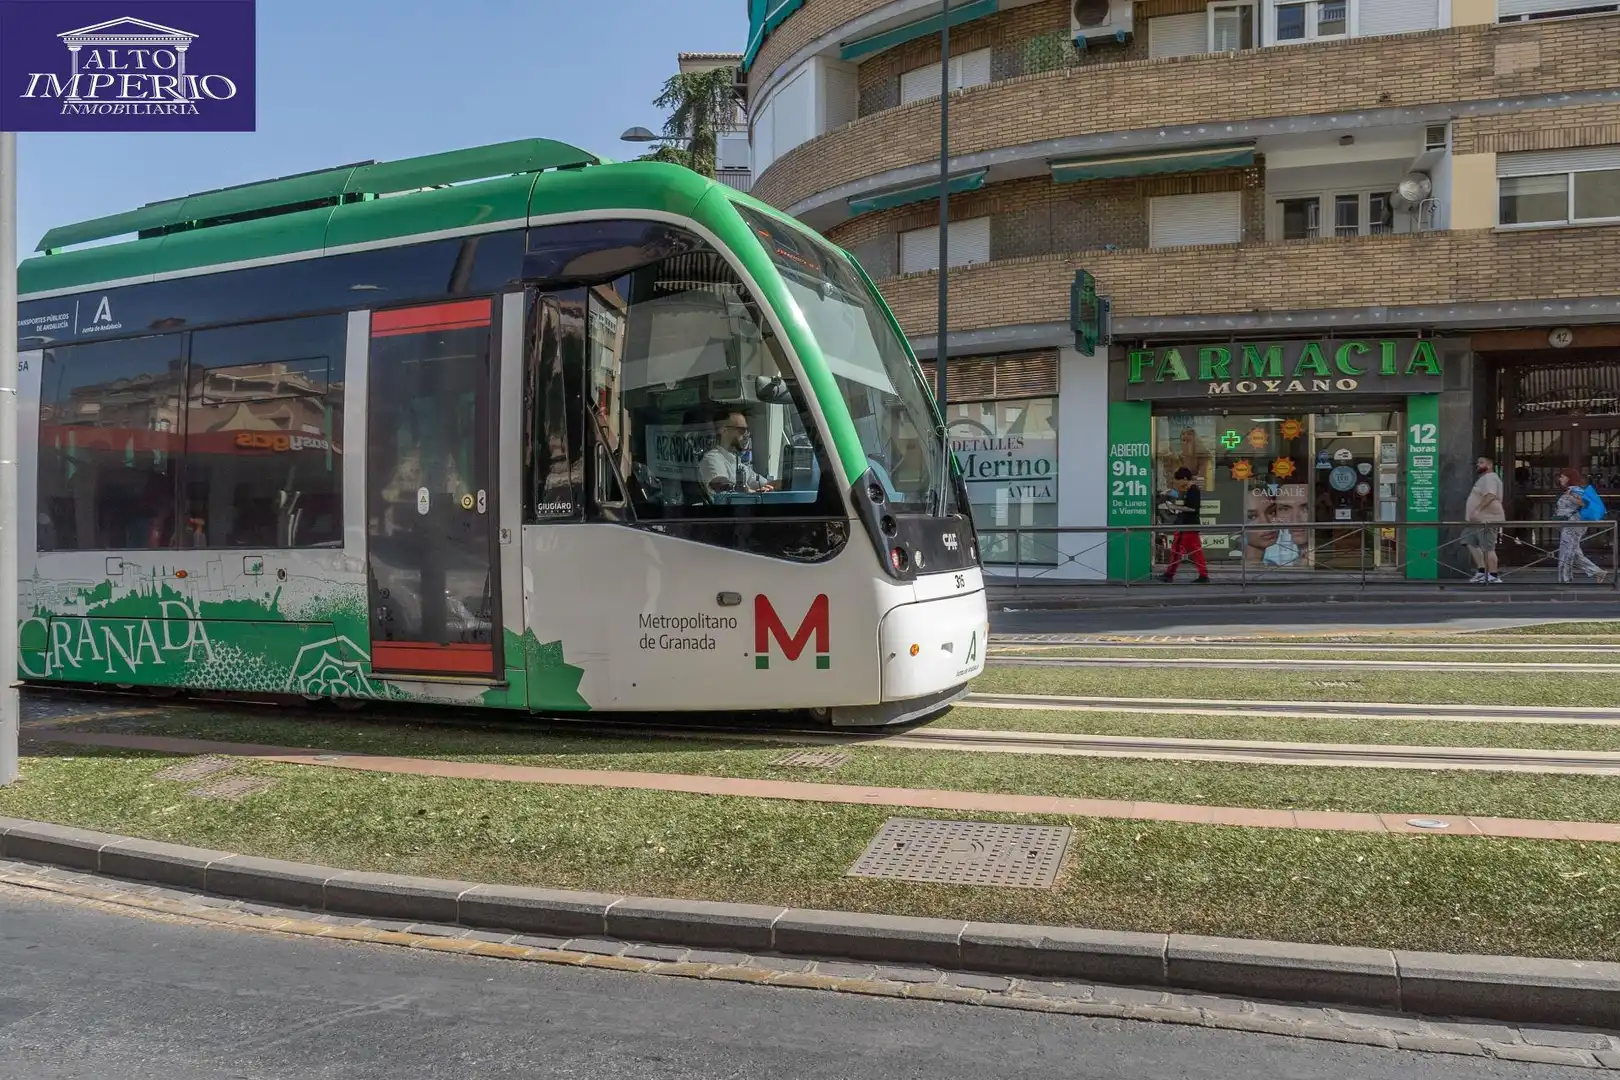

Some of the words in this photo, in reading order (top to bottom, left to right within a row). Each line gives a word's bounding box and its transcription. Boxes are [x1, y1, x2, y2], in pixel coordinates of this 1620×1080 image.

[17, 316, 46, 326] RANSPORTES
[43, 320, 69, 331] ANDALUCÍA
[1128, 340, 1444, 384] FARMACIA
[1208, 379, 1358, 394] MOYANO
[1410, 423, 1436, 443] 12
[952, 436, 1024, 451] DETALLES
[1110, 443, 1149, 457] ABIERTO
[1410, 445, 1436, 453] horas
[956, 451, 1050, 478] Merino
[1112, 460, 1137, 476] 9h
[1007, 482, 1052, 498] ÁVILA
[1112, 480, 1147, 496] 21h
[537, 502, 572, 510] GIUGIARO
[639, 612, 738, 633] Metropolitano
[17, 600, 217, 678] GRANADA
[754, 593, 830, 670] M
[639, 633, 656, 650] de
[659, 633, 716, 650] Granada
